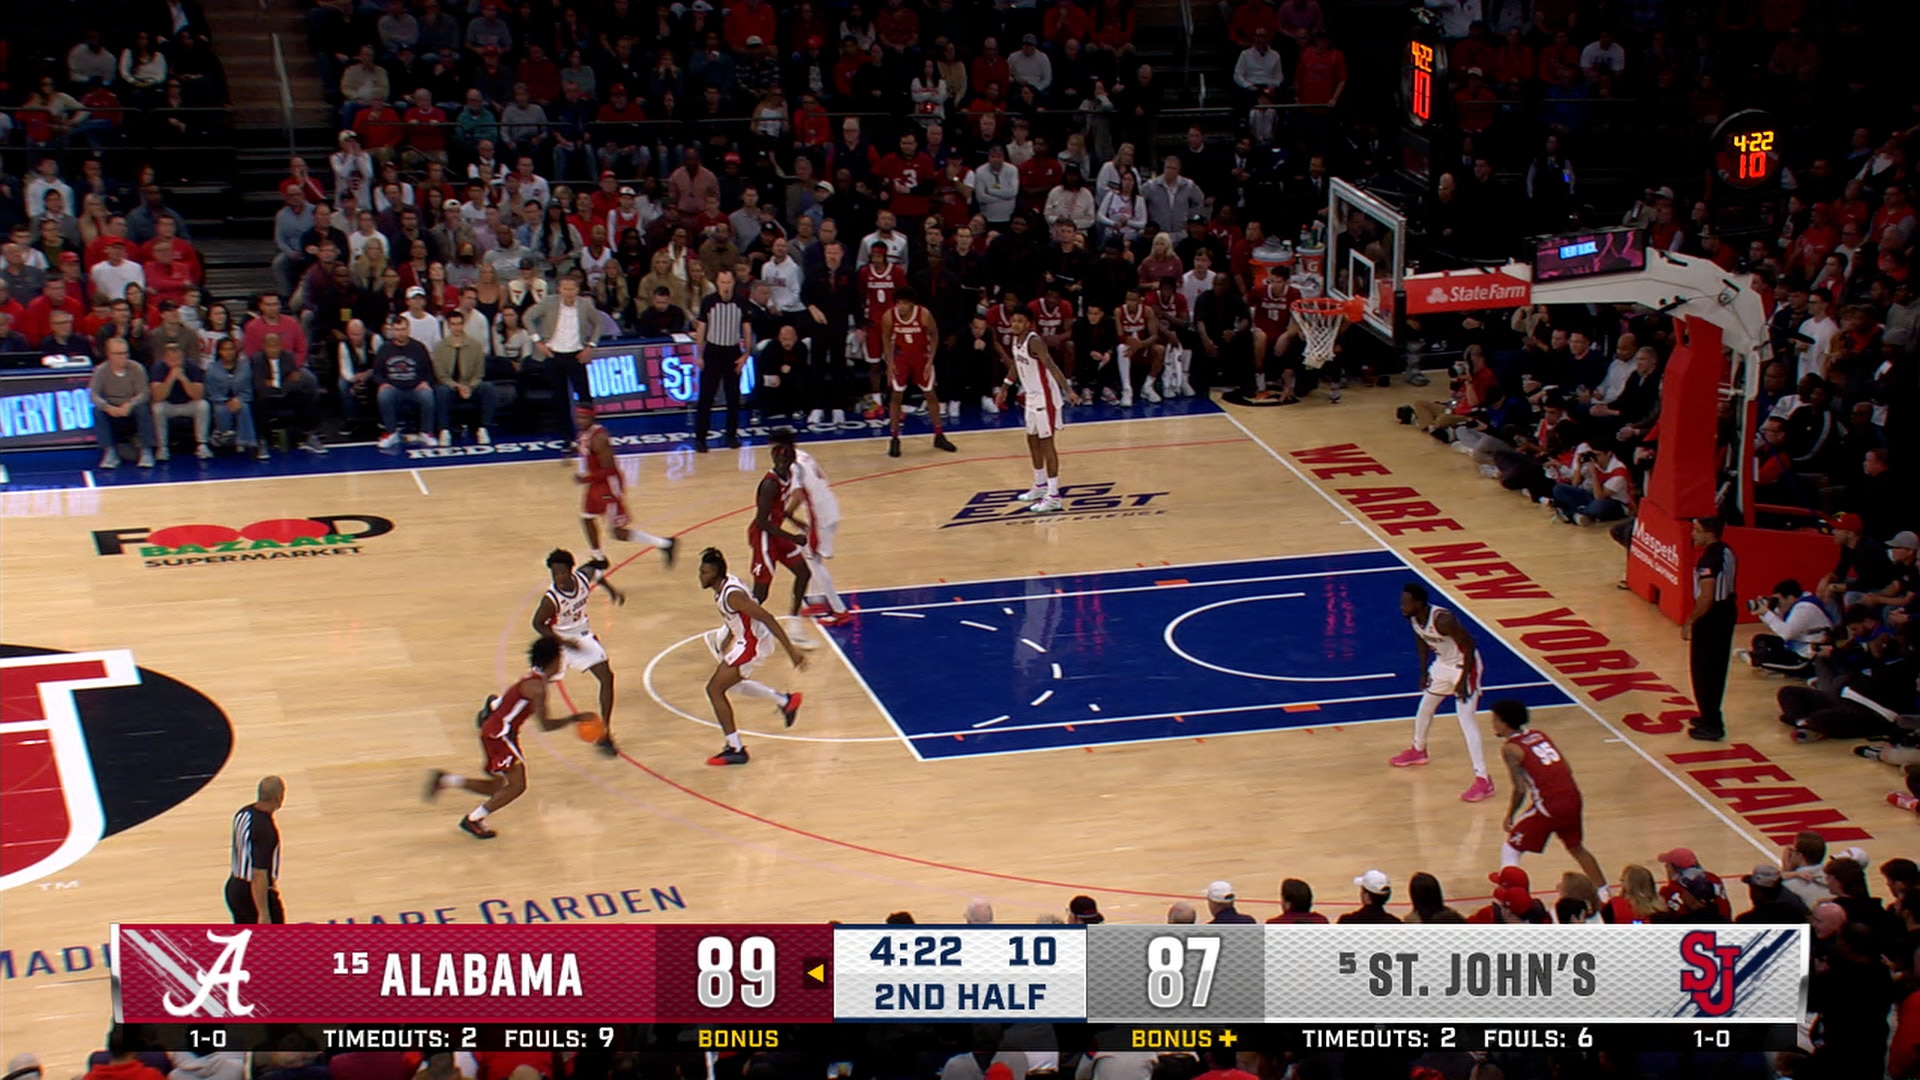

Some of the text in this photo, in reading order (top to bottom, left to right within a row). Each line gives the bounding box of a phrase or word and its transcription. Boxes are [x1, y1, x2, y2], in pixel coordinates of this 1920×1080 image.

[1413, 68, 1431, 119] 10
[1733, 130, 1774, 152] 4:22
[1739, 151, 1766, 179] 10
[0, 391, 57, 437] VERY
[91, 514, 394, 556] FOOD
[140, 533, 356, 557] BAZAAR
[1631, 517, 1680, 567] Maspeth
[144, 546, 363, 568] SUPERMARKET
[1288, 443, 1875, 847] WE ARE NEW YORK'S TEAM
[39, 880, 81, 891] TM
[478, 885, 688, 924] GARDEN
